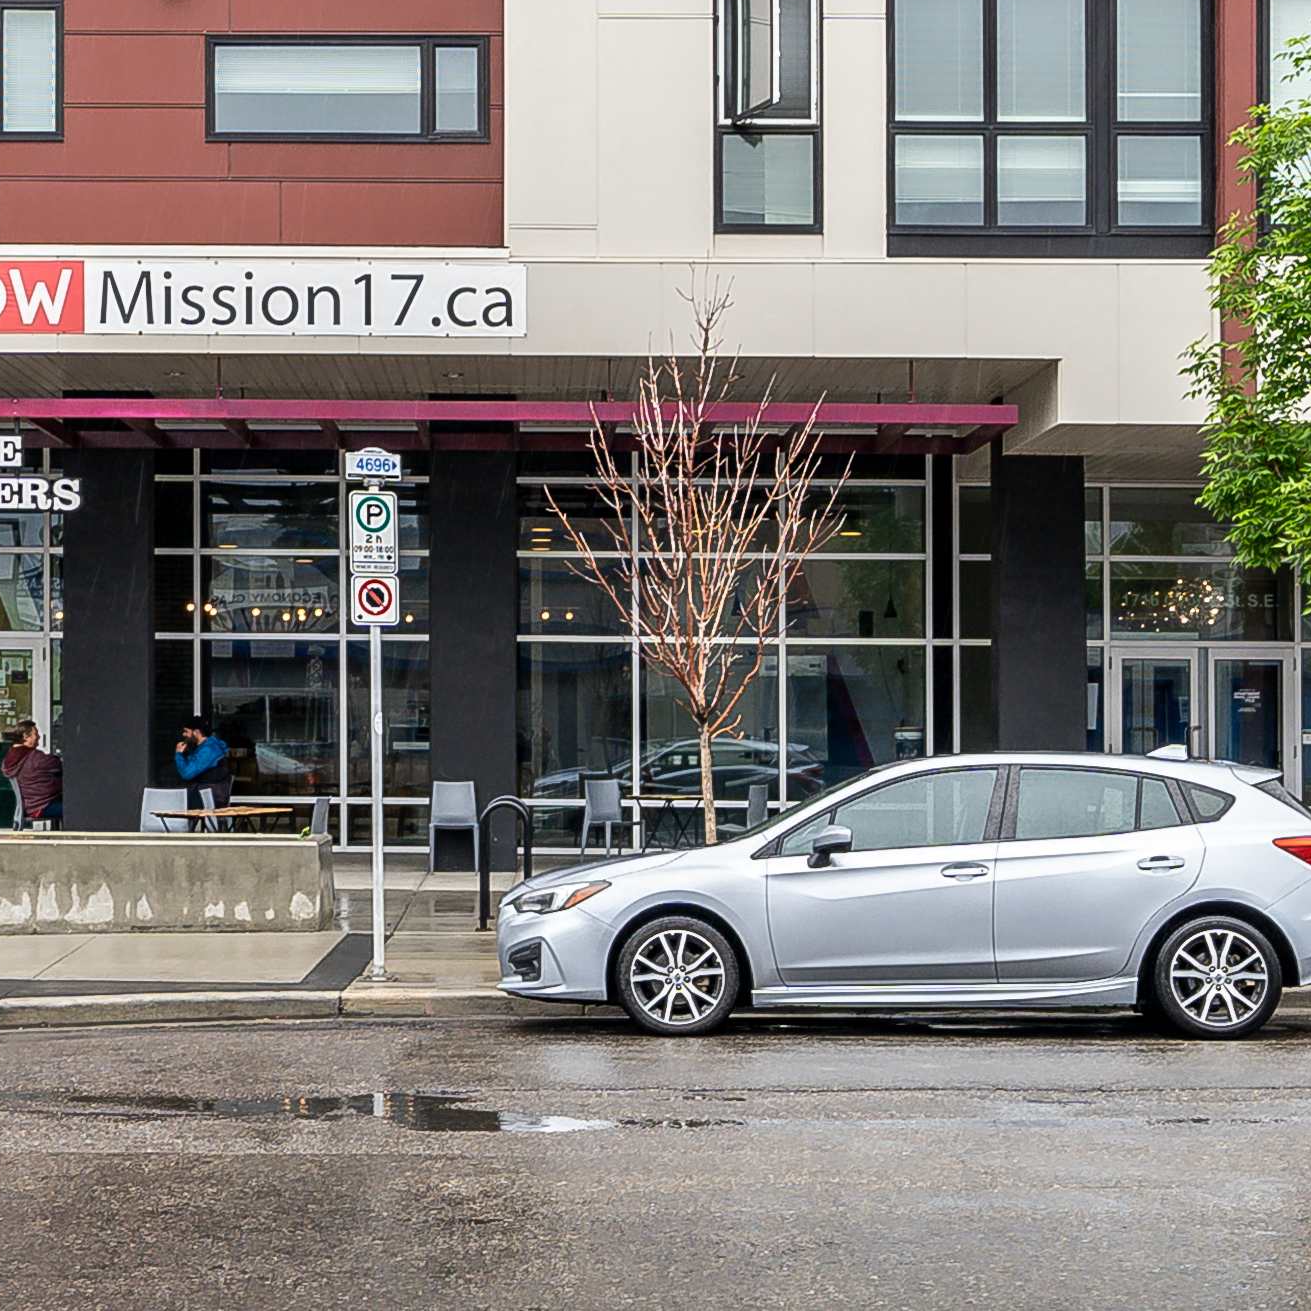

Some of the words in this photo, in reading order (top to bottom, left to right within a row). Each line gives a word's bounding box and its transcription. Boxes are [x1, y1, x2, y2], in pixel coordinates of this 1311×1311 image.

[98, 270, 514, 328] Mission17.ca
[355, 457, 391, 473] 4696
[367, 504, 383, 525] P
[365, 534, 373, 544] 2
